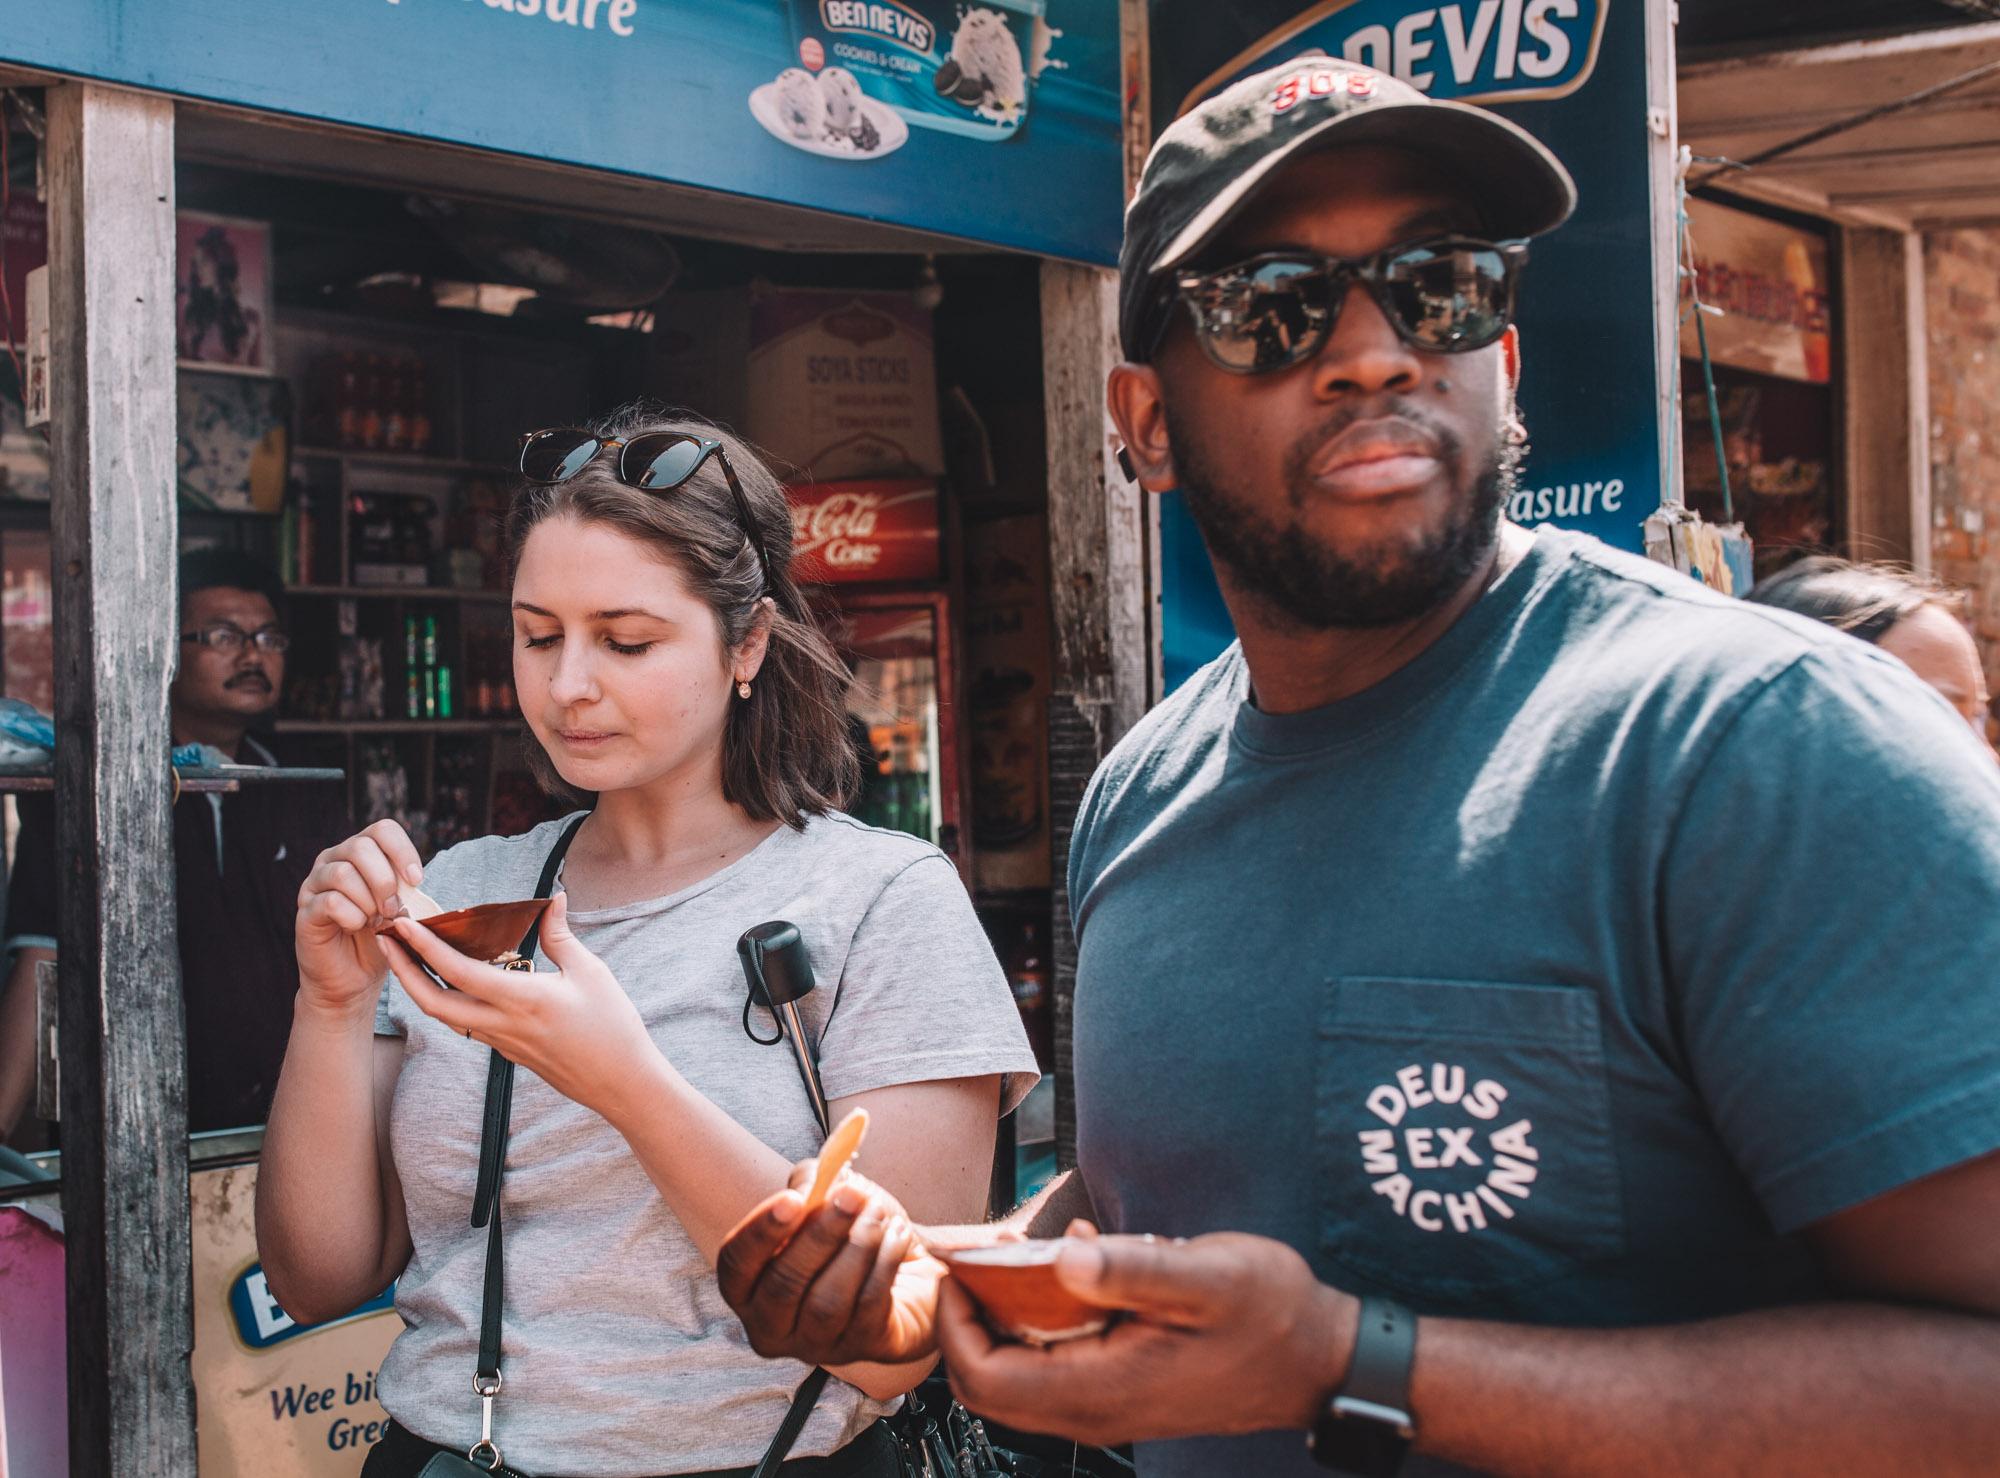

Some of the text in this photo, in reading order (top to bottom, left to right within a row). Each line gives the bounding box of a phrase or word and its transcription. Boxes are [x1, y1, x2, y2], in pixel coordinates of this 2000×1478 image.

[827, 0, 929, 50] BEN NEVIS
[833, 42, 878, 65] COOKIES
[888, 55, 922, 73] CREAM
[807, 355, 910, 384] SOYA STICKS
[1366, 1062, 1508, 1126] DEUS
[1405, 1127, 1483, 1168] EX
[1358, 1119, 1539, 1233] MACHINA
[271, 1383, 335, 1421] Wee
